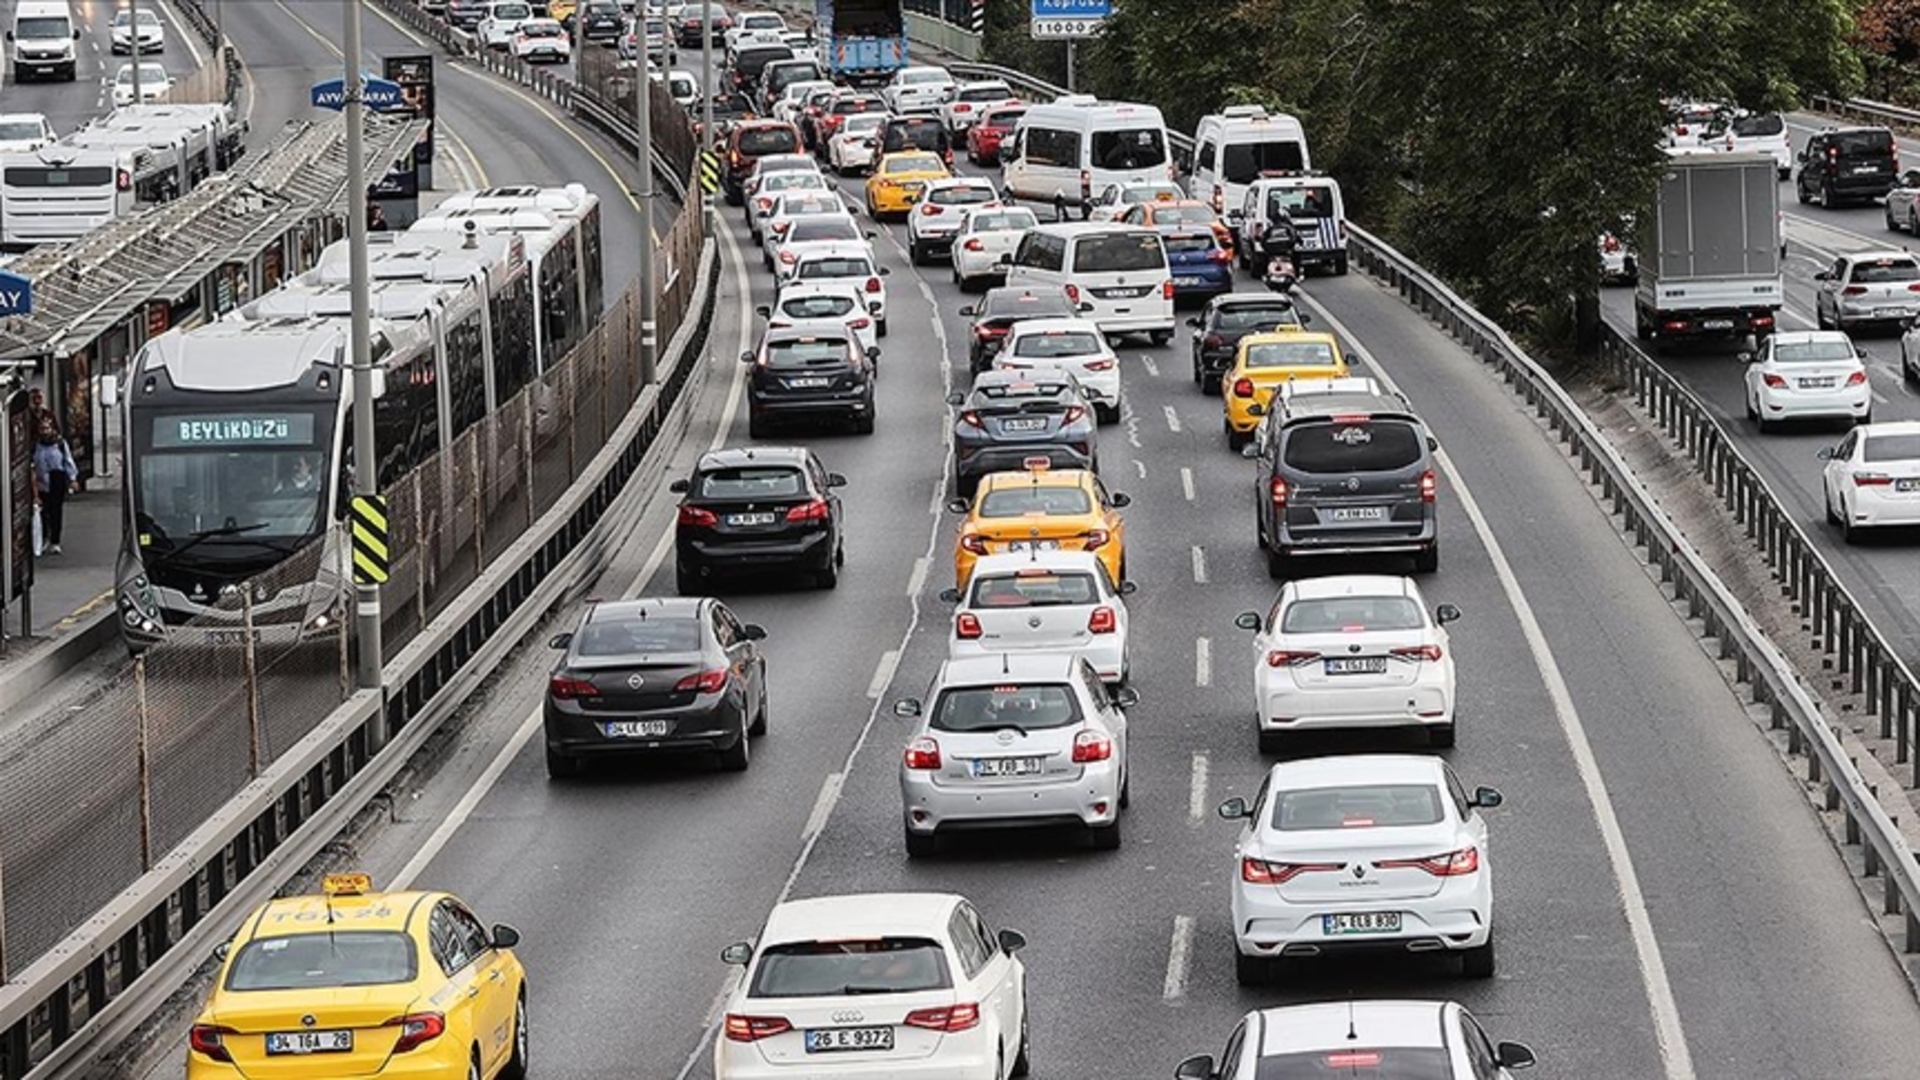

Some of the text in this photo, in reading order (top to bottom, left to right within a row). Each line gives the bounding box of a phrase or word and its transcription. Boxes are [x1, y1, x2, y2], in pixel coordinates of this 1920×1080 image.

[275, 1032, 349, 1049] 34 TGA 28
[814, 1030, 891, 1047] 26 E 9372
